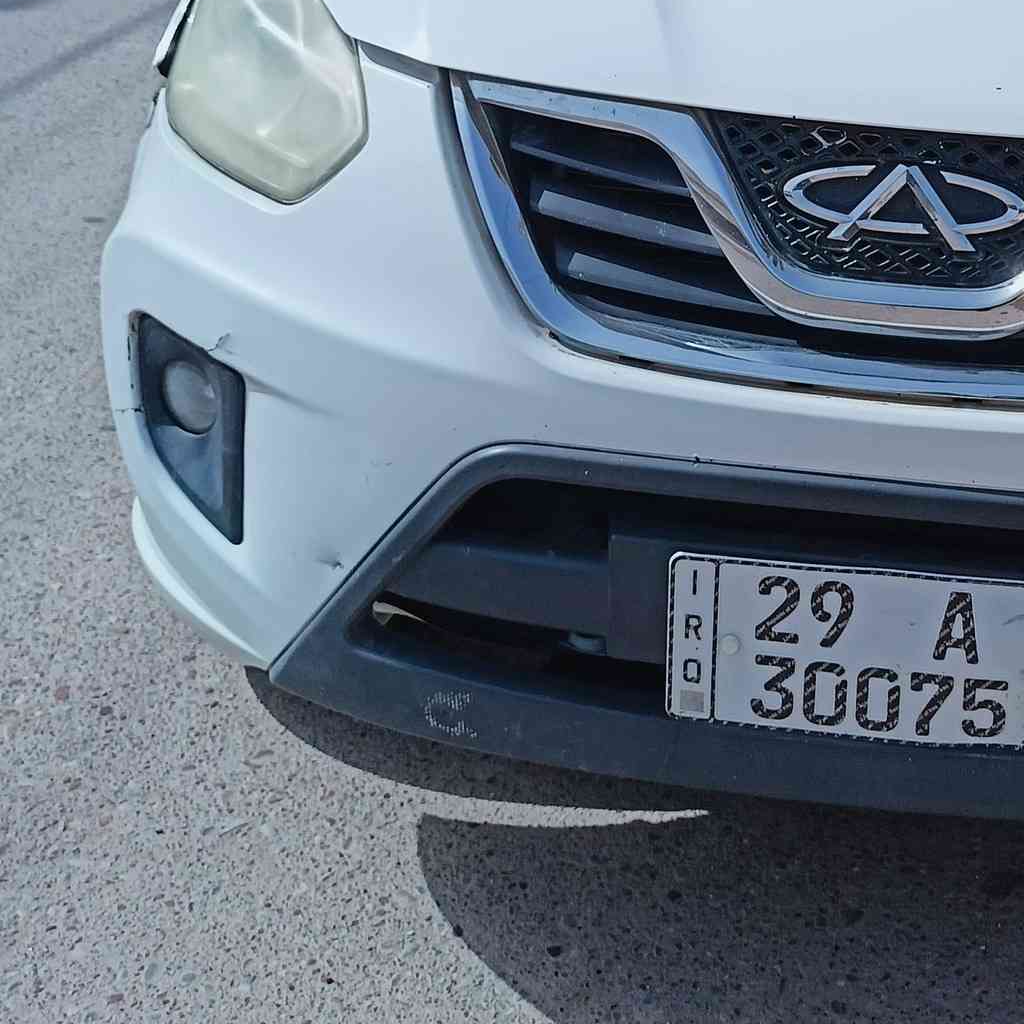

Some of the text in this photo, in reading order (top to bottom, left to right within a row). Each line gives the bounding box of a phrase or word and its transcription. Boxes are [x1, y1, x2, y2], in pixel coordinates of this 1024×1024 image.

[683, 569, 703, 684] IRQ
[754, 575, 855, 648] 29
[933, 591, 980, 664] A
[750, 653, 1009, 738] 30075
